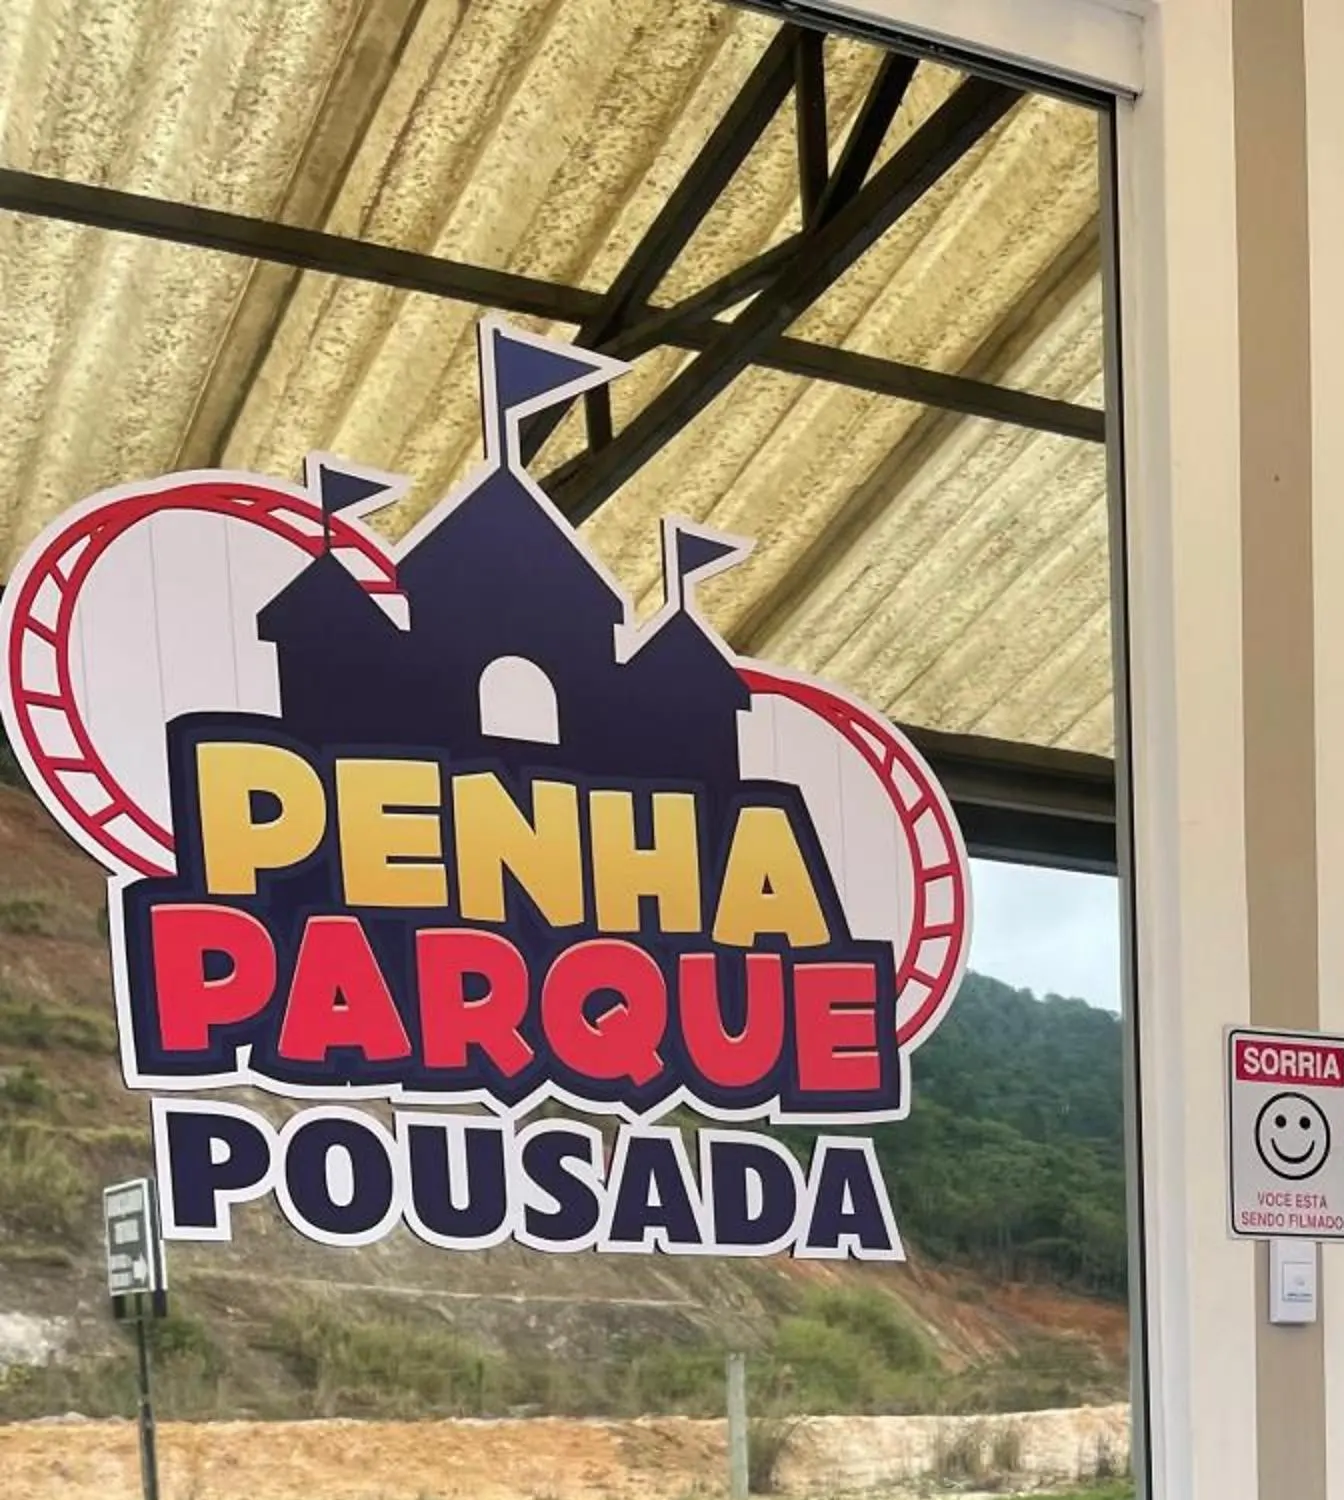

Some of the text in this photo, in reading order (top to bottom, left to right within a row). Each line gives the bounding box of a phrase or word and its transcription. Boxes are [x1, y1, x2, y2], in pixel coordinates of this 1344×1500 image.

[195, 741, 830, 948] PENHA
[149, 903, 882, 1092] PARQUE
[1243, 1047, 1341, 1080] SORRIA
[164, 1108, 894, 1252] POUSADA
[1241, 1211, 1344, 1231] SENDO FILMADO
